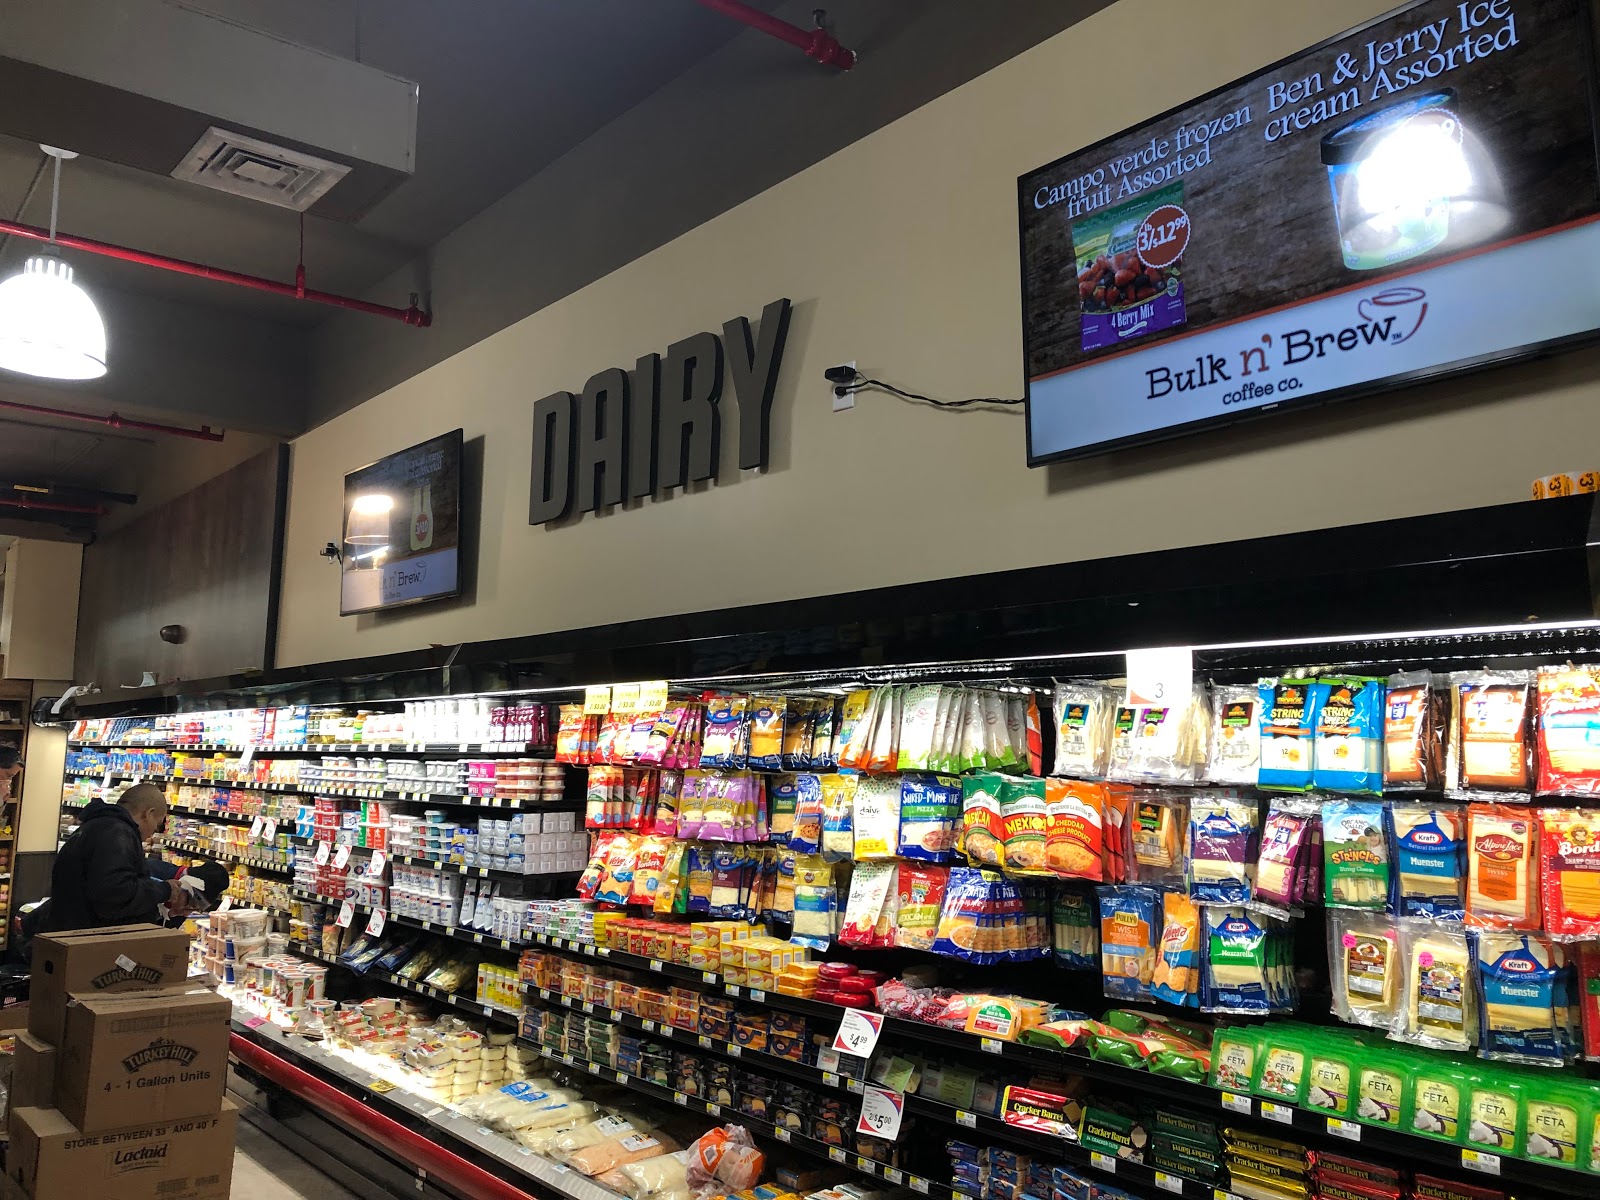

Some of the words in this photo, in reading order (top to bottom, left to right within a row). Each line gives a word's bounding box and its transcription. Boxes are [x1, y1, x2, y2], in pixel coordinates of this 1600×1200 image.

[1266, 72, 1325, 114] Ben
[1332, 52, 1359, 85] &
[1362, 17, 1451, 83] Jerry
[1456, 0, 1511, 34] Ice
[1264, 87, 1361, 142] cream
[1370, 13, 1519, 100] Assorted
[1034, 168, 1105, 210] Campo
[1109, 138, 1170, 178] verde
[1175, 105, 1252, 153] frozen
[1066, 183, 1113, 220] fruit
[1117, 141, 1213, 200] Assorted
[1111, 315, 1116, 328] 4
[1117, 311, 1139, 327] Berry
[1140, 303, 1155, 319] Mix
[1145, 354, 1231, 400] Bulk
[1281, 315, 1397, 366] Brew
[1222, 382, 1275, 406] coffee
[1278, 376, 1304, 393] co.
[528, 297, 791, 526] DAIRY
[397, 571, 421, 586] Brew
[1155, 682, 1164, 699] 3
[1271, 708, 1304, 718] STRING
[1320, 707, 1355, 717] STRING
[1056, 820, 1085, 830] CHEDDAR
[1066, 828, 1092, 844] PRODUCT
[1476, 838, 1506, 852] Alpine
[1505, 840, 1522, 852] Lace
[1410, 857, 1444, 868] Muenster
[1114, 926, 1138, 934] TWISTS
[1221, 949, 1254, 958] Mozzarella
[1501, 986, 1539, 998] Muenster
[126, 1047, 170, 1069] TURKEY
[171, 1046, 194, 1063] HILL
[1227, 1056, 1246, 1066] FETA
[1275, 1063, 1295, 1073] FETA
[1318, 1070, 1342, 1082] FETA
[104, 1082, 111, 1093] 4
[126, 1080, 131, 1090] 1
[136, 1074, 176, 1088] Gallon
[180, 1070, 210, 1082] Units
[1368, 1080, 1393, 1093] FETA
[1422, 1092, 1449, 1104] FETA
[1014, 1103, 1041, 1116] Cracker
[1041, 1108, 1064, 1122] Barrel
[1479, 1104, 1506, 1116] FETA
[1536, 1116, 1566, 1128] FETA
[64, 1139, 100, 1150] STORE
[102, 1129, 152, 1145] BETWEEN
[173, 1123, 194, 1134] AND
[212, 1119, 218, 1128] F
[1088, 1125, 1112, 1138] Cracker
[1111, 1133, 1130, 1146] Barrel
[114, 1144, 168, 1165] Lactaid
[1260, 1144, 1280, 1156] Barrel
[1156, 1156, 1177, 1168] Cracker
[1178, 1163, 1196, 1174] Barrel
[1234, 1156, 1258, 1169] Cracker
[1260, 1162, 1280, 1174] Barrel
[1318, 1158, 1346, 1173] Cracker
[1346, 1166, 1369, 1180] Barrel
[1320, 1184, 1348, 1200] Cracker
[1417, 1184, 1448, 1199] Cracker
